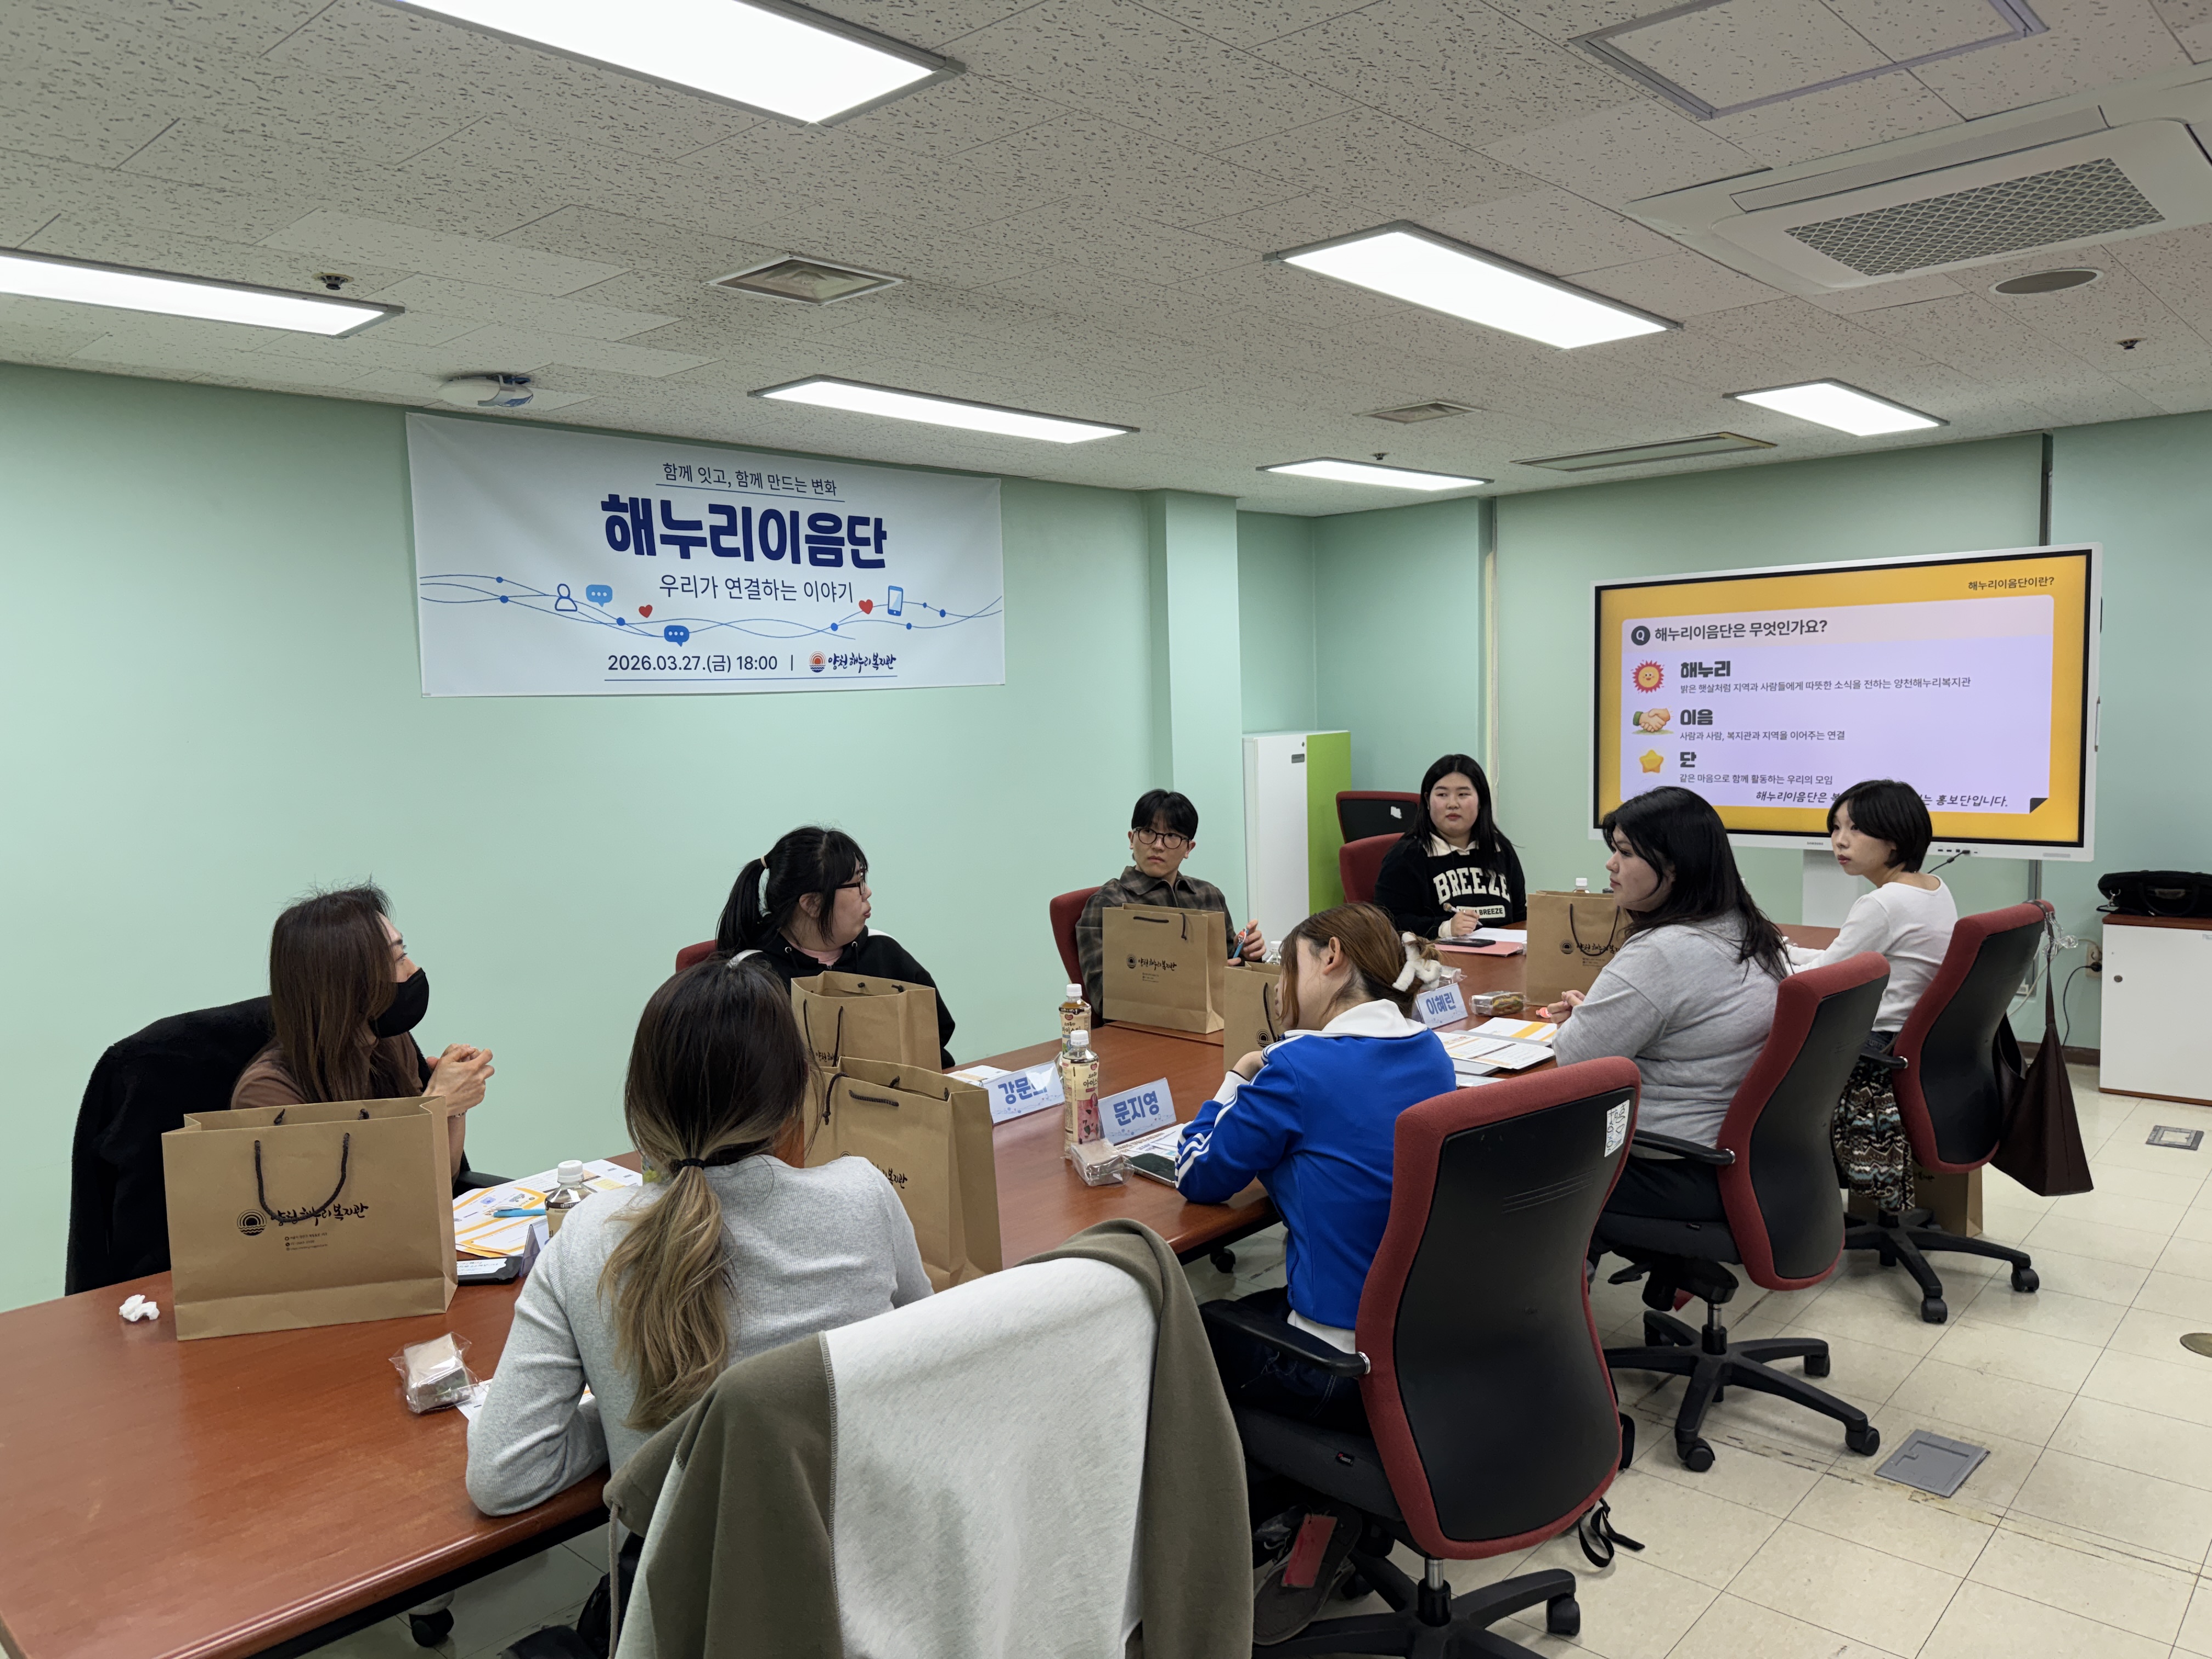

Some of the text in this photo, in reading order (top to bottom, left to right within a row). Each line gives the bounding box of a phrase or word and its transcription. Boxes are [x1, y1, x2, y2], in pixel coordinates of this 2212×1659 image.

[663, 462, 837, 496] 함께 잇고, 함께 만드는 변화
[601, 494, 887, 569] 해누리이음단
[659, 574, 853, 603] 우리가 연결하는 이야기
[1968, 577, 2055, 591] 해누리이음단이란?
[1655, 623, 1746, 641] 해누리이음단은
[1750, 620, 1827, 636] 무엇인가요?
[608, 654, 777, 673] 2026.03.27.(금) 18:00
[1680, 661, 1731, 678] 해누리
[1680, 677, 1971, 693] 밝은 햇살처럼 지역과 사람들에게 따뜻한 소식을 전하는 양천해누리복지관
[1680, 709, 1713, 725] 이음
[1680, 730, 1845, 741] 사람과 사람, 복지관과 지역을 이어주는 연결
[1680, 752, 1696, 768] 단
[1679, 774, 1832, 785] 같은 마음으로 함께 활동하는 우리의 모임
[1756, 791, 1827, 803] 해누리이음단은
[1936, 795, 2008, 807] 홍보단입니다.
[1433, 867, 1511, 905] BREEZE
[1426, 992, 1456, 1014] 이혜린
[1113, 1091, 1159, 1126] 문지영
